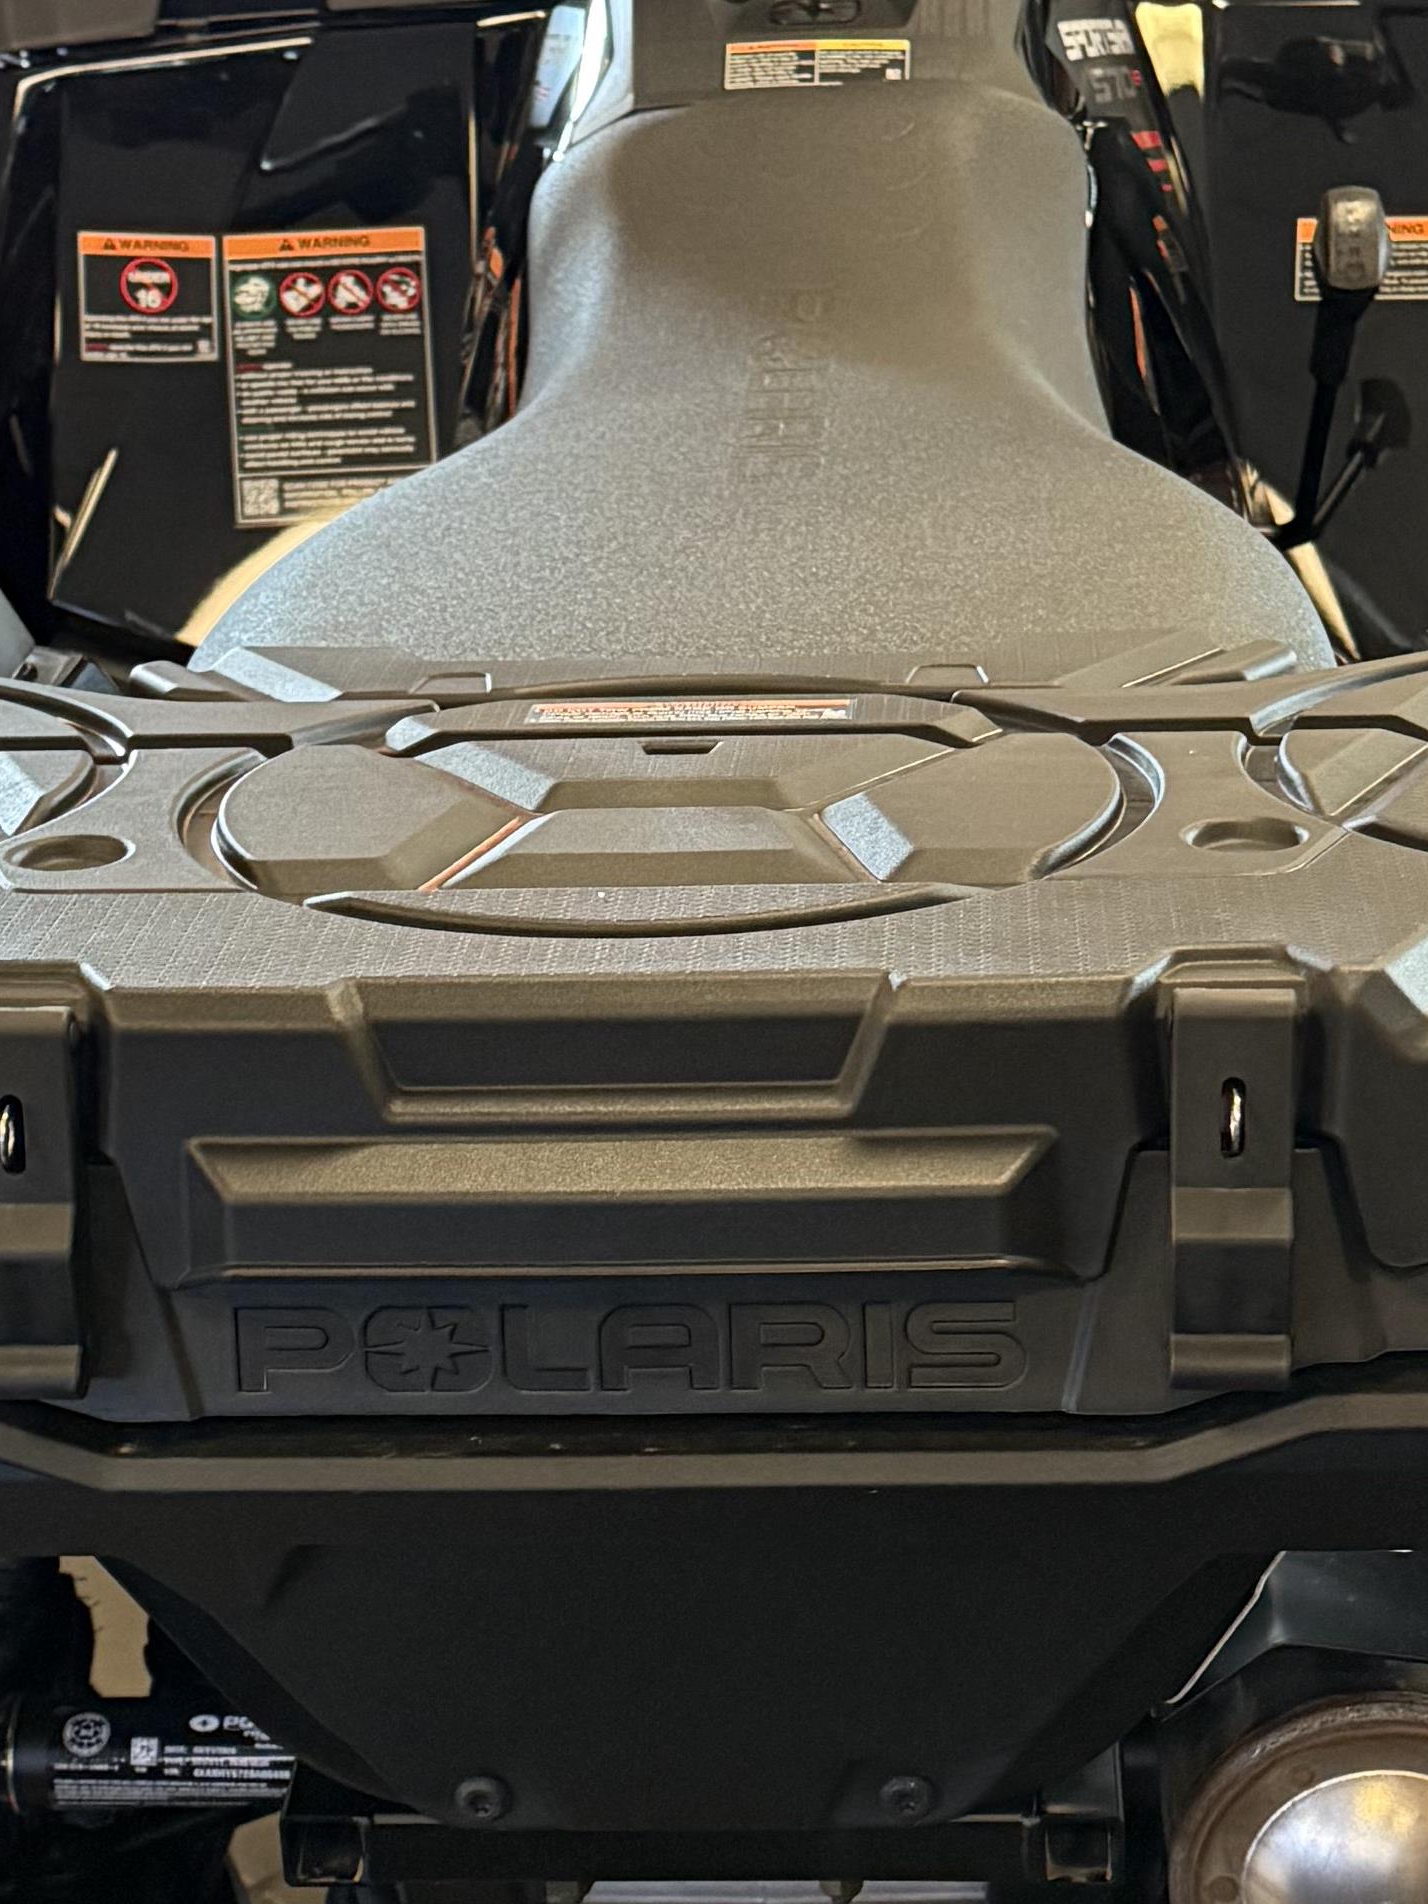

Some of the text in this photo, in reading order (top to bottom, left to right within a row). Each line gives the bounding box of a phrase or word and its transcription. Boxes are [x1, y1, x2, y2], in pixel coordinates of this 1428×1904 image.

[119, 238, 190, 253] WARNING
[297, 235, 371, 250] WARNING
[233, 1301, 1032, 1395] POLARIS
